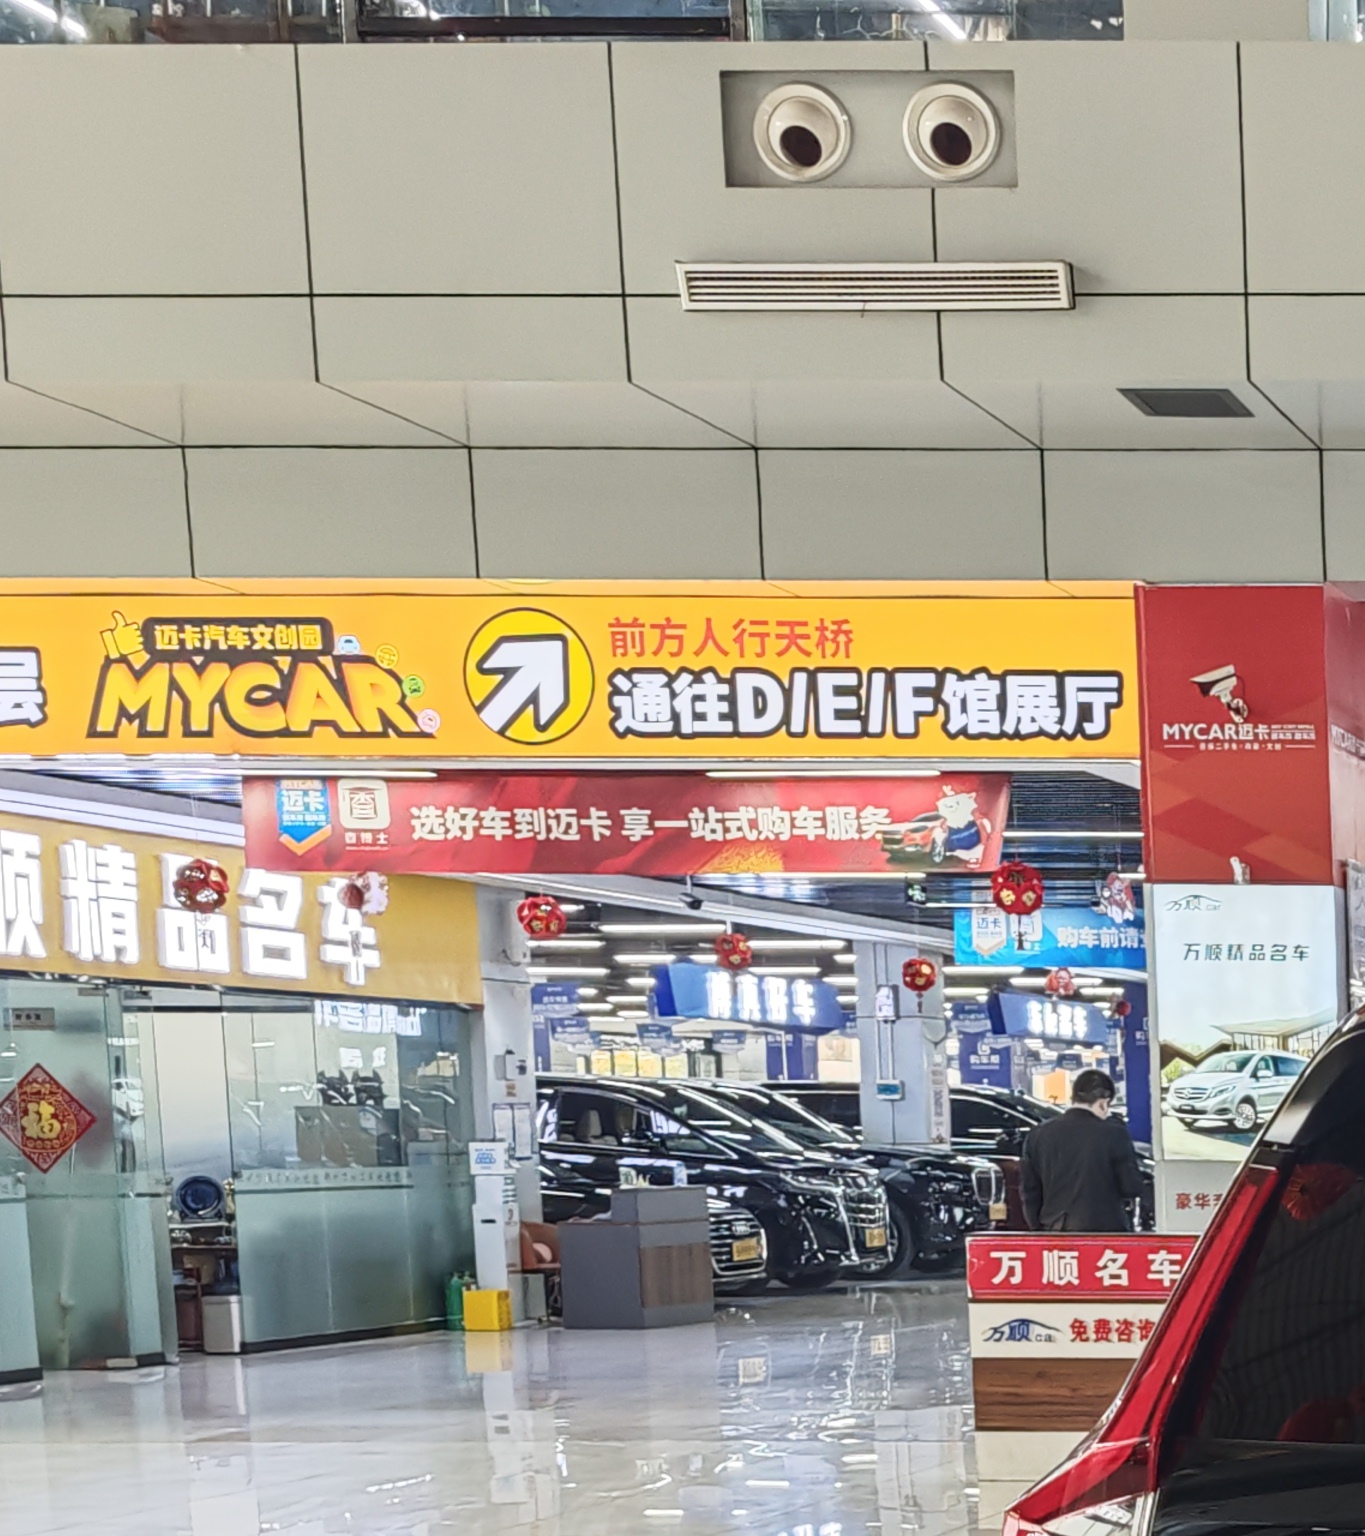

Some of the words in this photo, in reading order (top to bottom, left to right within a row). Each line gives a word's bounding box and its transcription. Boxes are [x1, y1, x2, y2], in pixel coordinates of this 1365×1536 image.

[153, 625, 322, 651] 迈卡汽车文创园
[608, 617, 854, 659] 前方人行天桥
[92, 657, 430, 738] MYCAR
[610, 671, 1121, 737] 通往D/E/F馆展厅
[411, 806, 612, 842] 选好车到迈卡
[621, 805, 893, 842] 享一站式购车服务
[1057, 926, 1146, 949] 购车前请
[1183, 943, 1311, 962] 万顺精品名车
[989, 1249, 1183, 1287] 万顺名车
